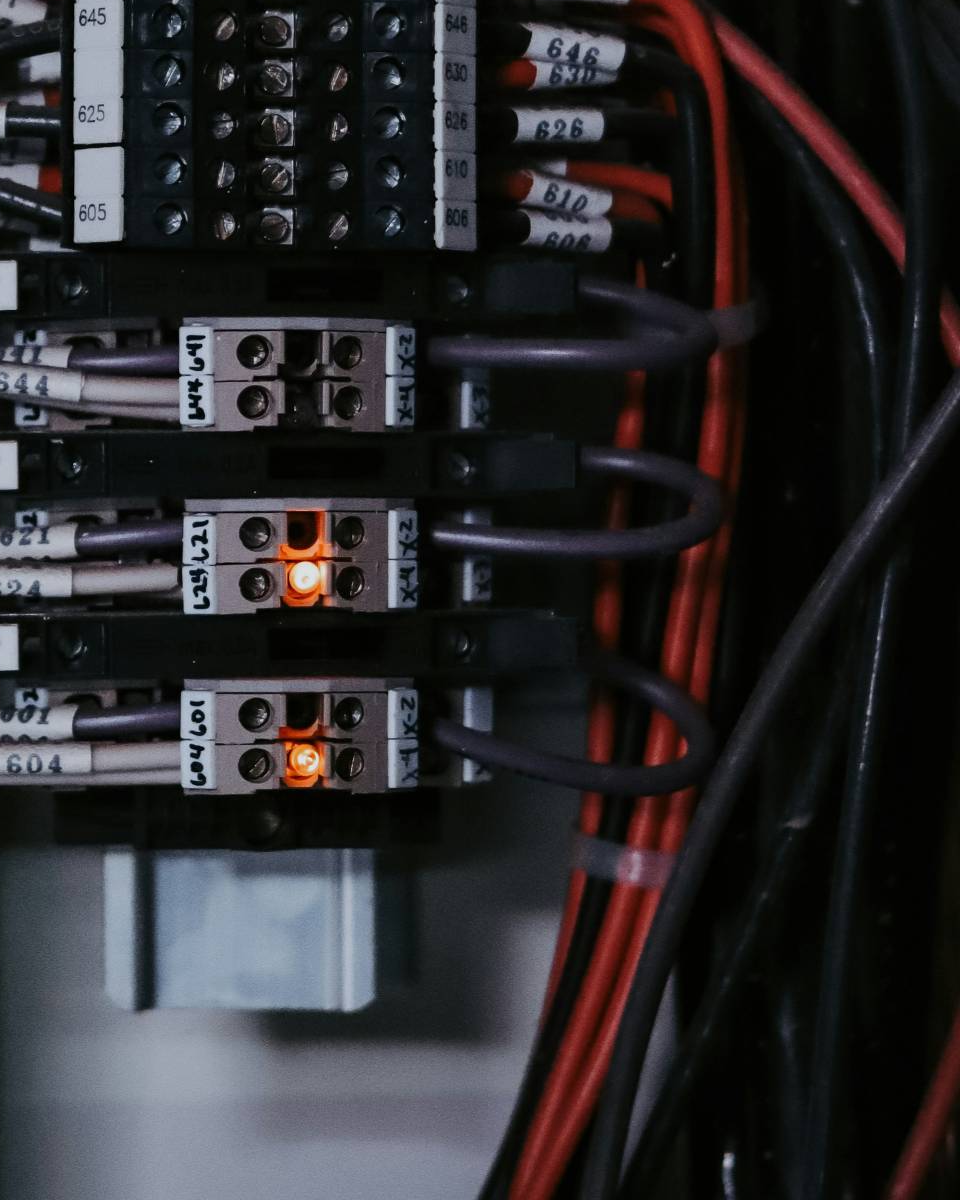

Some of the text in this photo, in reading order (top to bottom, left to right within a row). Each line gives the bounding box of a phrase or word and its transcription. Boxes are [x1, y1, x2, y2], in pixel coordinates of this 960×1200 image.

[79, 8, 106, 26] 645
[446, 14, 467, 33] 646
[547, 38, 600, 65] 646
[446, 64, 467, 82] 630
[78, 104, 104, 122] 625
[445, 111, 468, 130] 626
[535, 118, 584, 140] 626
[446, 160, 468, 177] 610
[544, 183, 588, 212] 610
[79, 204, 106, 221] 605
[446, 209, 468, 227] 606
[186, 335, 205, 371] 641
[189, 701, 205, 737] 601
[6, 753, 63, 774] 604
[189, 745, 206, 787] 604
